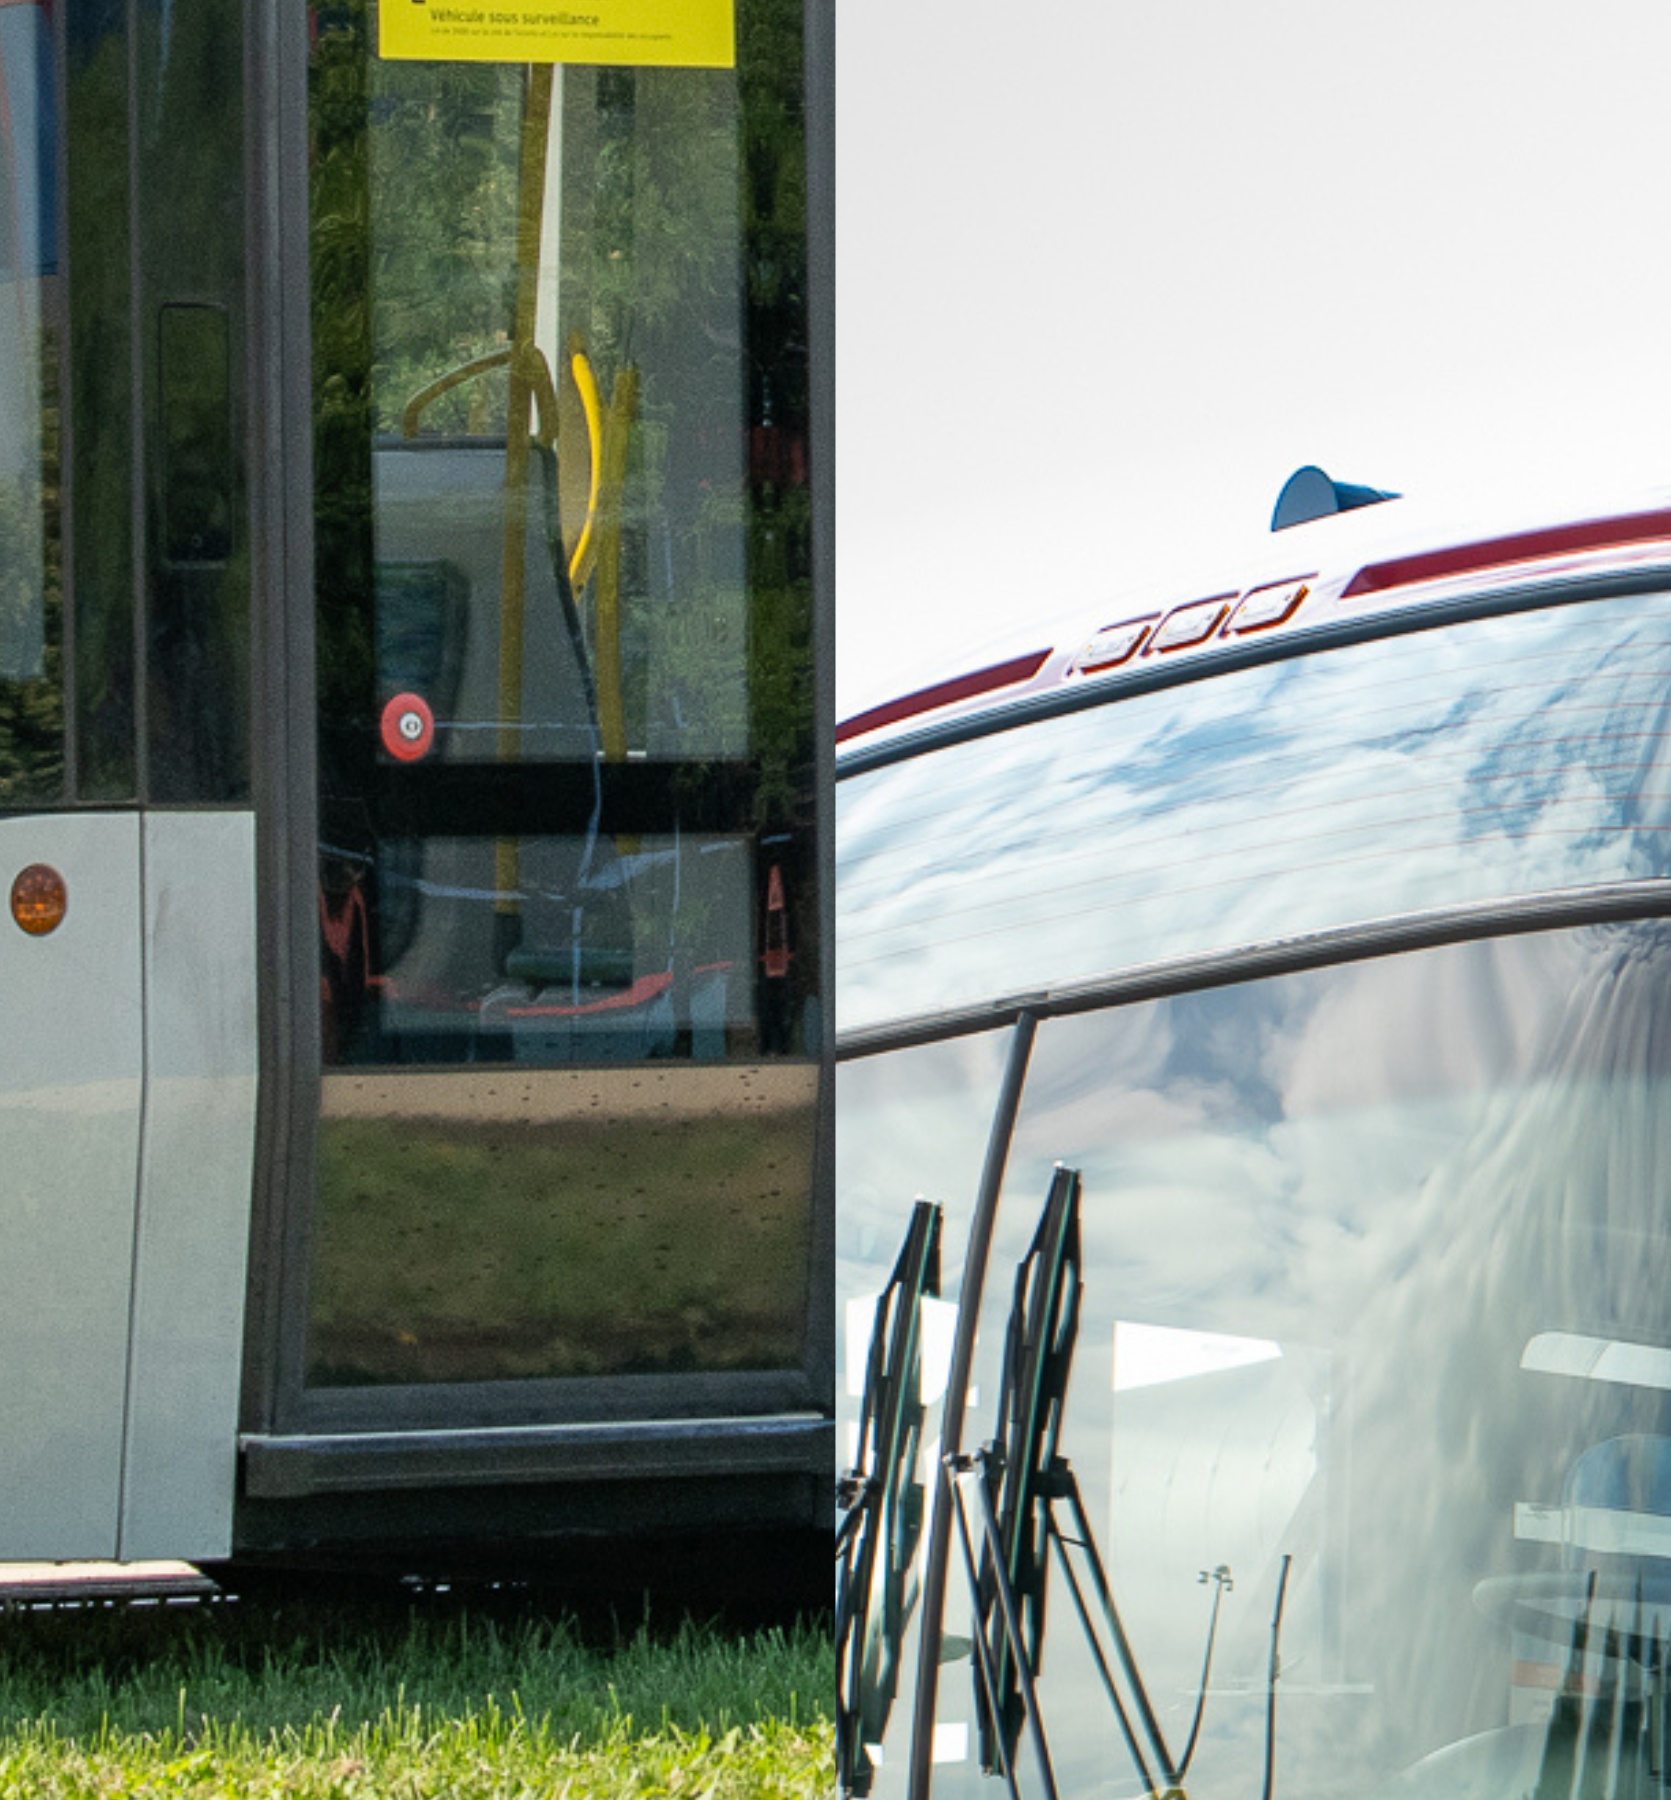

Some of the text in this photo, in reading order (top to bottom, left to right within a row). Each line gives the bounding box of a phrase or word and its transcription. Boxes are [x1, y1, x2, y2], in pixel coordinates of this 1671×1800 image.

[430, 9, 599, 26] Véhicule sous surveillance
